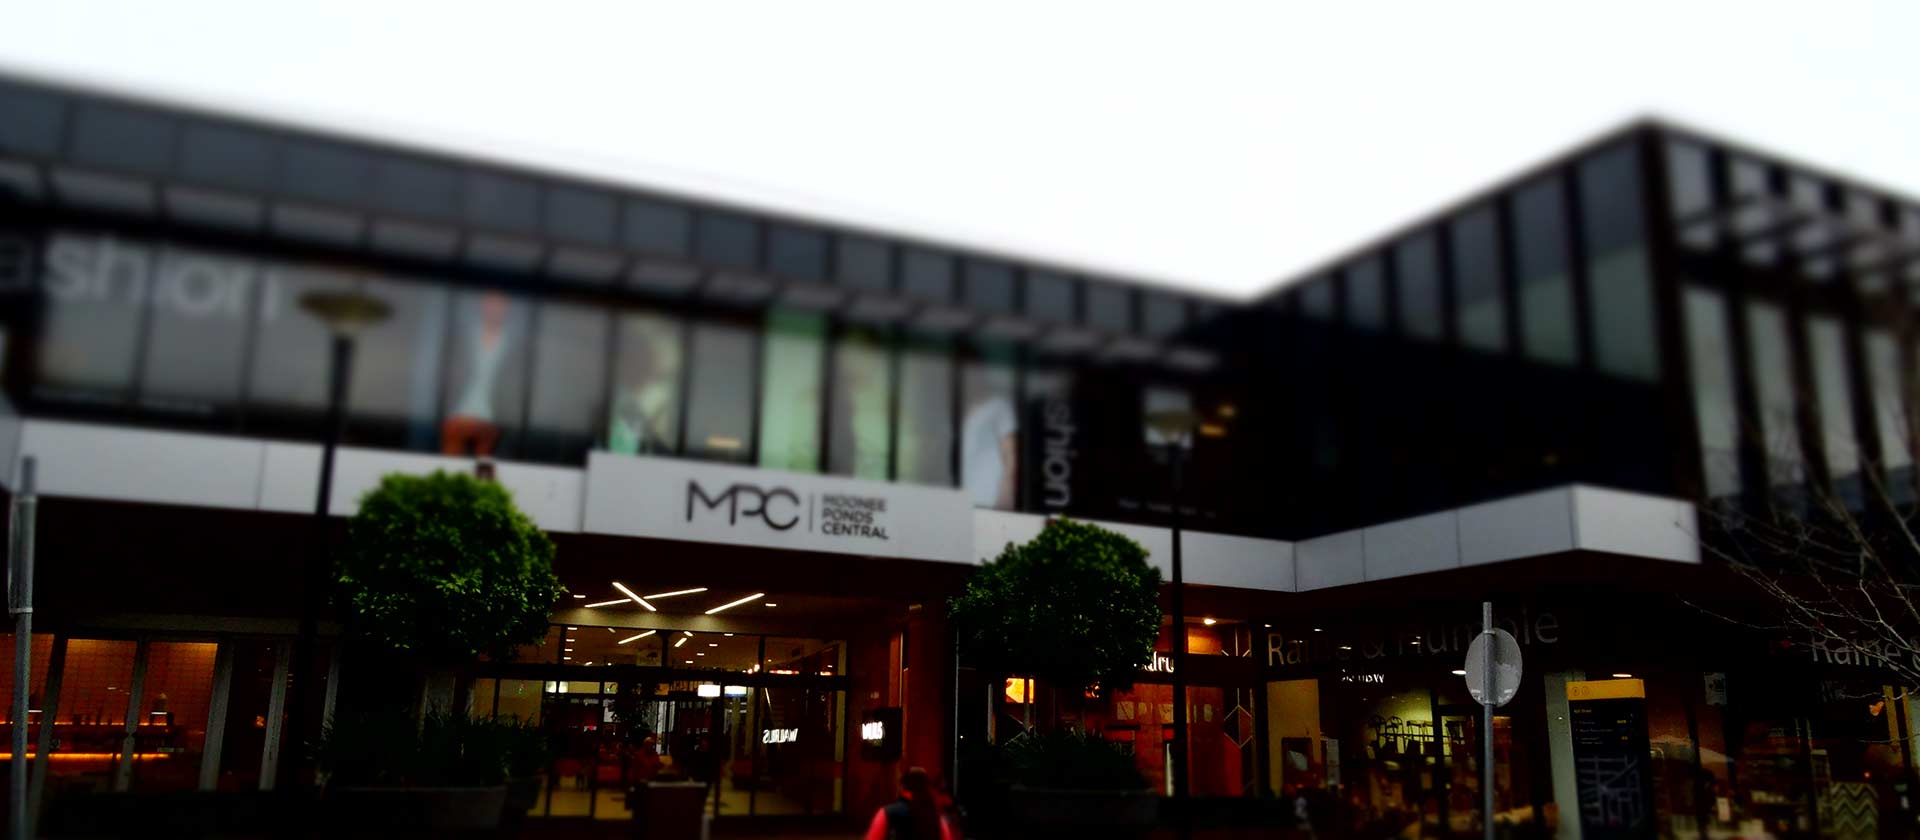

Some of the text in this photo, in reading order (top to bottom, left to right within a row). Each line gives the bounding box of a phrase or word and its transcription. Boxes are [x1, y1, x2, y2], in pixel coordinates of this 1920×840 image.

[1043, 392, 1078, 508] shion
[686, 481, 800, 531] MPC
[822, 494, 887, 513] MOONEE
[822, 508, 873, 525] PONDS
[822, 522, 889, 541] CENTRAL
[1266, 633, 1352, 668] Raie
[1398, 602, 1560, 657] Humle
